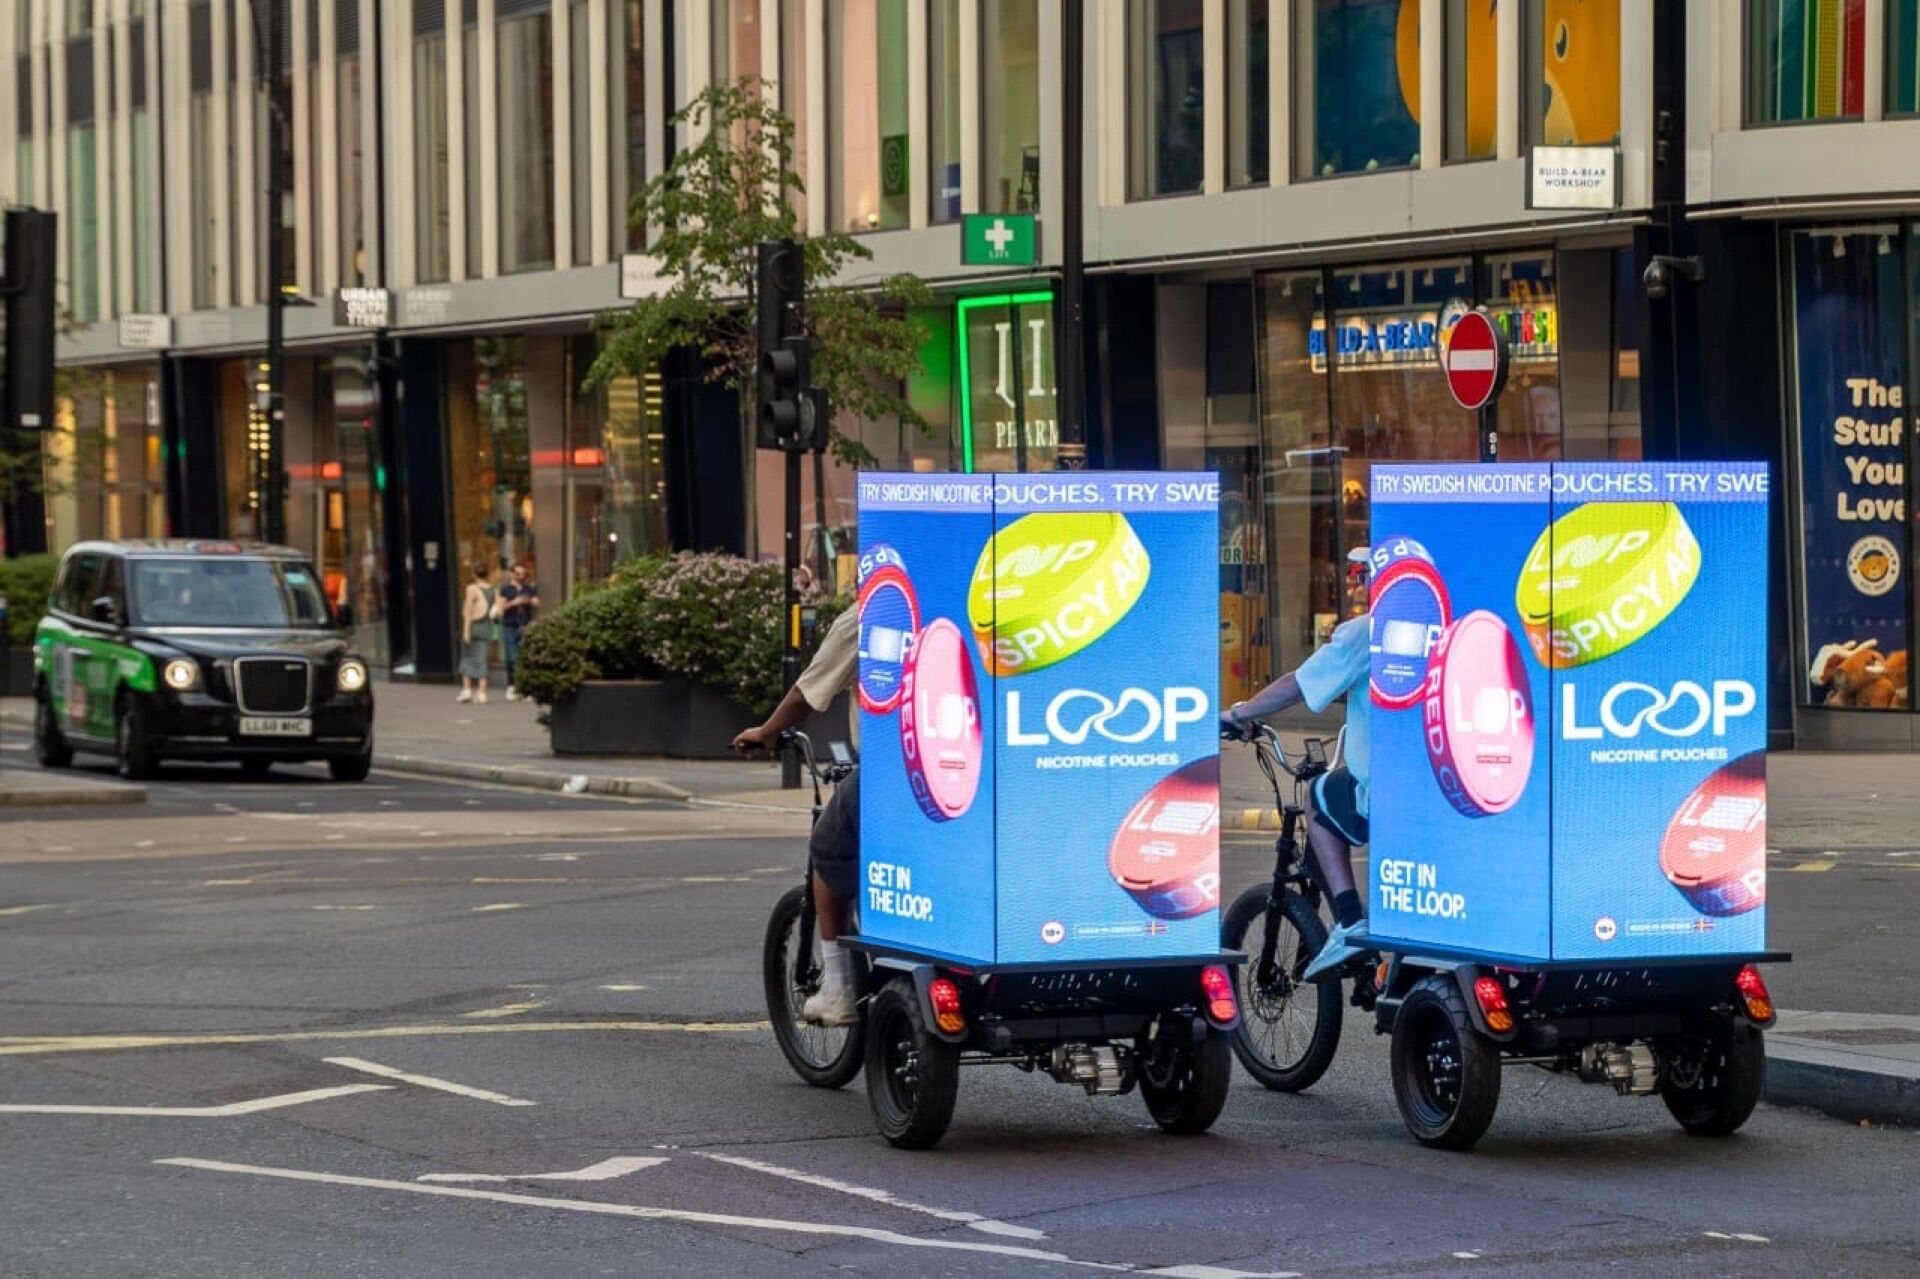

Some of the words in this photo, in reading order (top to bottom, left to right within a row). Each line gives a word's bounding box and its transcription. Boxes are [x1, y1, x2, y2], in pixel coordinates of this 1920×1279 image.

[1545, 179, 1601, 188] WORKSHOP
[1846, 378, 1902, 408] The
[995, 419, 1059, 449] PHARM
[1834, 416, 1902, 446] Stuf
[1376, 474, 1400, 493] TRY
[1403, 474, 1464, 494] SWEDISH
[1468, 473, 1535, 493] NICOTINE
[1665, 473, 1711, 492] TRY
[1716, 472, 1769, 493] SWE
[1845, 456, 1904, 485] You
[862, 484, 879, 501] TRY
[882, 484, 928, 502] SWEDISH
[931, 484, 981, 503] NICOTINE
[1112, 483, 1159, 502] TRY
[1166, 482, 1219, 502] SWE
[987, 579, 1112, 667] SPICY
[1547, 568, 1665, 659] SPICY
[1006, 687, 1209, 746] LOOP
[1562, 680, 1756, 740] LOOP
[1036, 755, 1106, 769] NICOTINE
[1109, 753, 1180, 767] POUCHES
[1591, 748, 1659, 764] NICOTINE
[1661, 747, 1728, 762] POUCHES
[868, 861, 895, 888] GET
[896, 866, 911, 892] IN
[1380, 858, 1415, 887] GET
[1418, 863, 1436, 889] IN
[868, 887, 895, 914] THE
[896, 891, 934, 922] LOOP.
[1380, 884, 1413, 913] THE
[1416, 889, 1467, 919] LOOP.
